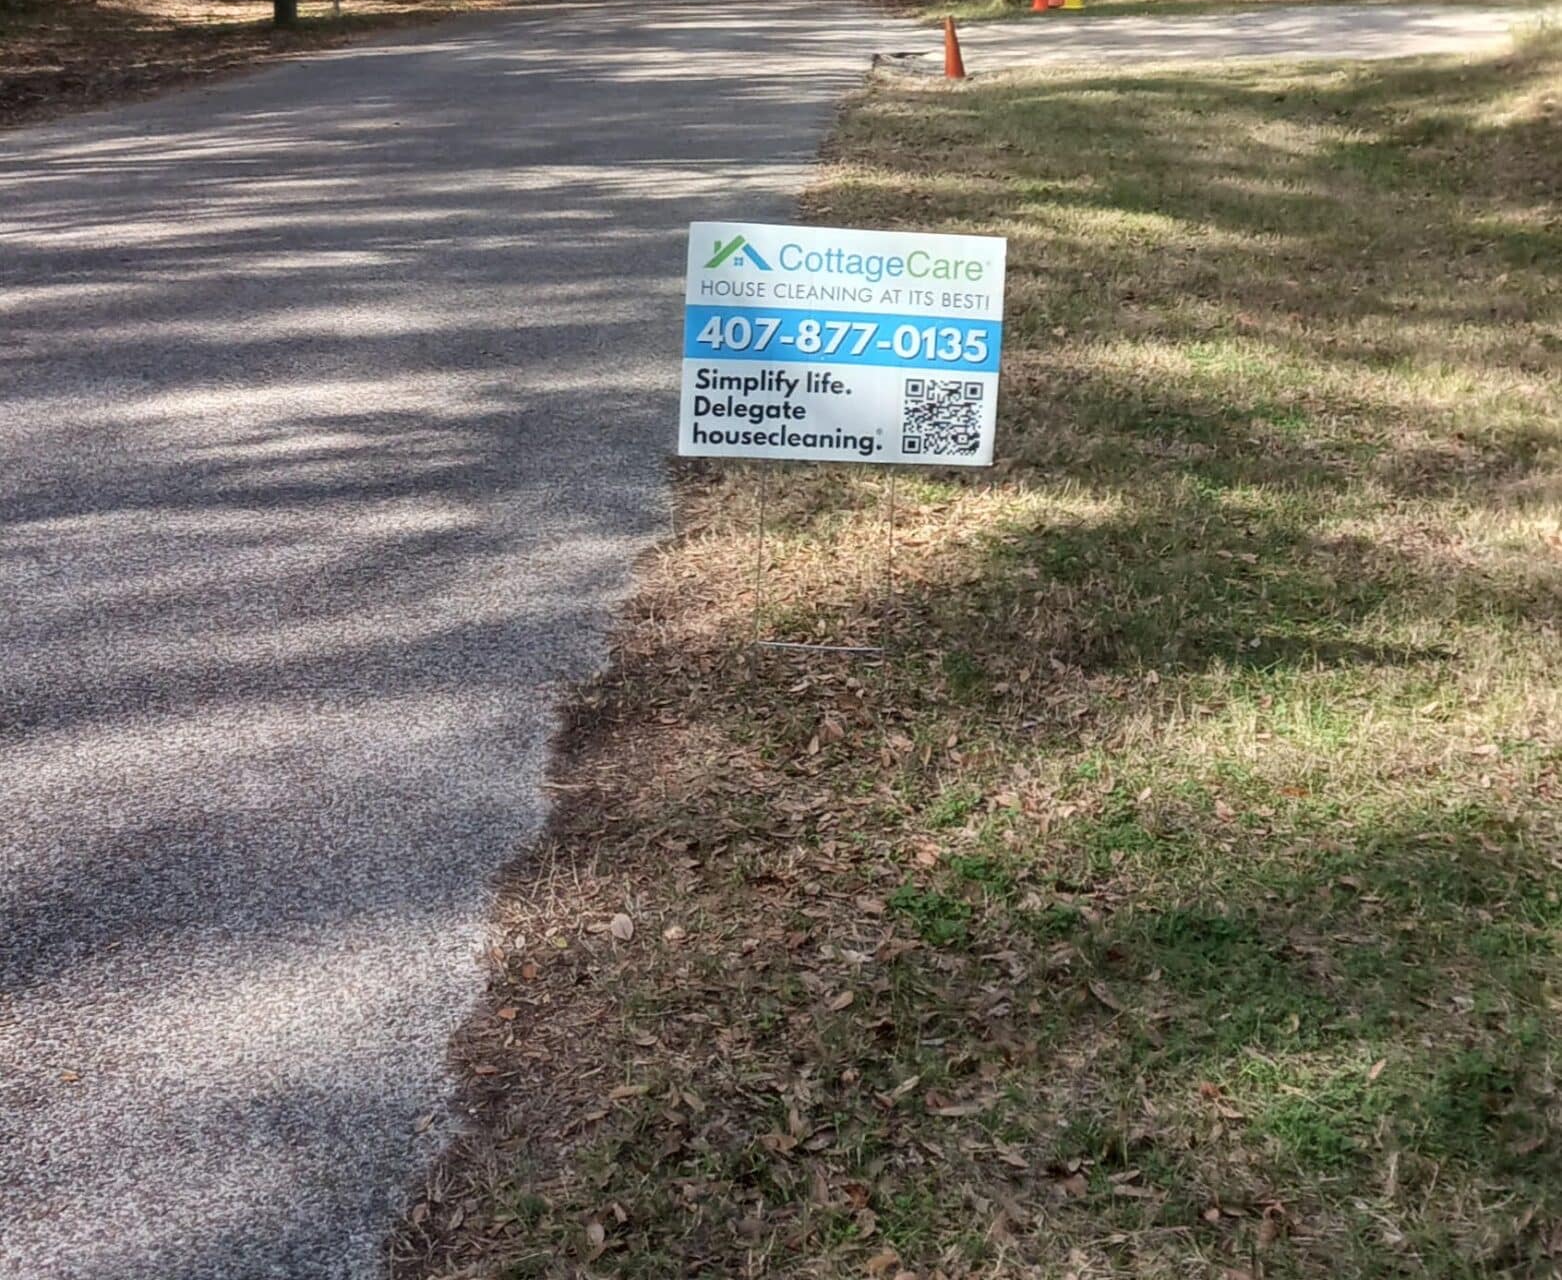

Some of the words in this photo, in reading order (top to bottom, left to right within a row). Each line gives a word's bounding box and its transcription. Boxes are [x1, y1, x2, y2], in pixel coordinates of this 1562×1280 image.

[779, 243, 983, 283] CottageCare
[701, 280, 766, 297] HOUSE
[773, 283, 873, 303] CLEANING
[880, 289, 901, 304] AT
[909, 290, 934, 306] ITS
[942, 293, 990, 310] BEST!
[695, 316, 990, 363] 407-877-0135
[695, 368, 800, 397] Simplify
[805, 372, 852, 394] life.
[694, 397, 806, 424] Delegate
[692, 423, 883, 456] housecleaning.
